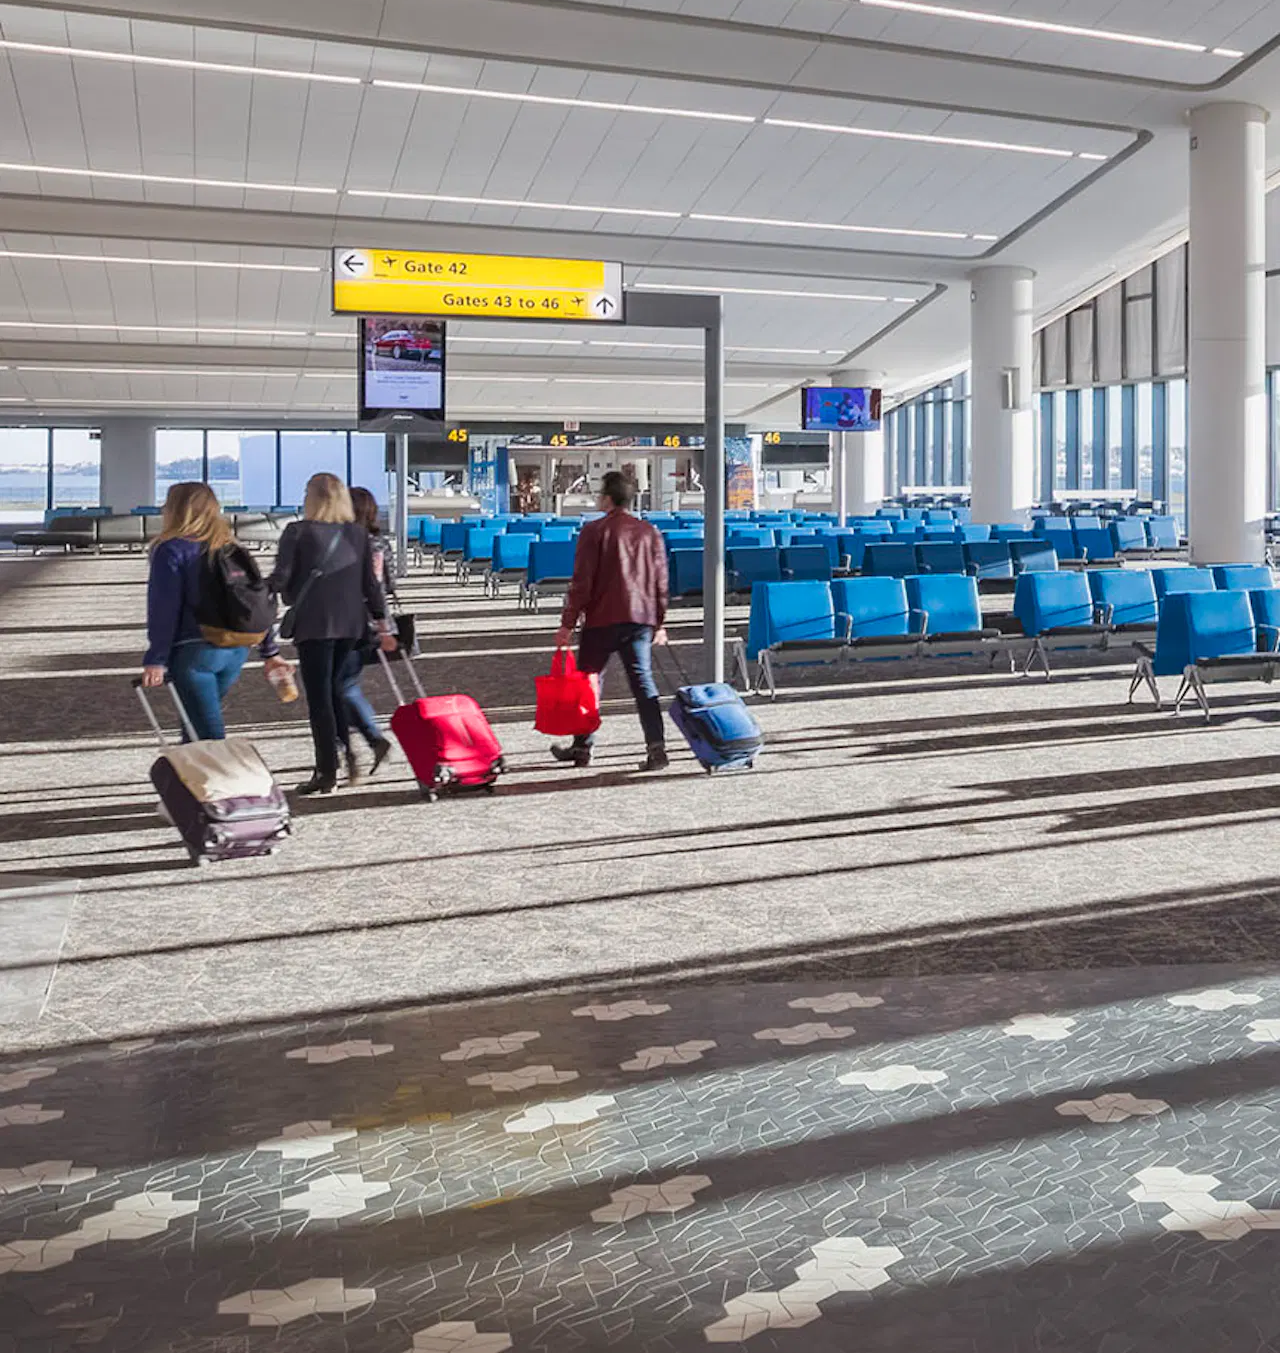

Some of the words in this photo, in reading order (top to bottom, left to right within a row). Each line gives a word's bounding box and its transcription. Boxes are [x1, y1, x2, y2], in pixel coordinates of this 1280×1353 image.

[404, 260, 443, 274] Gate
[449, 262, 467, 275] 42
[443, 293, 488, 307] Gates
[494, 295, 512, 308] 43
[519, 297, 535, 309] to
[541, 297, 559, 310] 46
[447, 429, 468, 442] 45
[550, 435, 568, 447] 45
[663, 435, 681, 447] 46
[764, 432, 781, 445] 46
